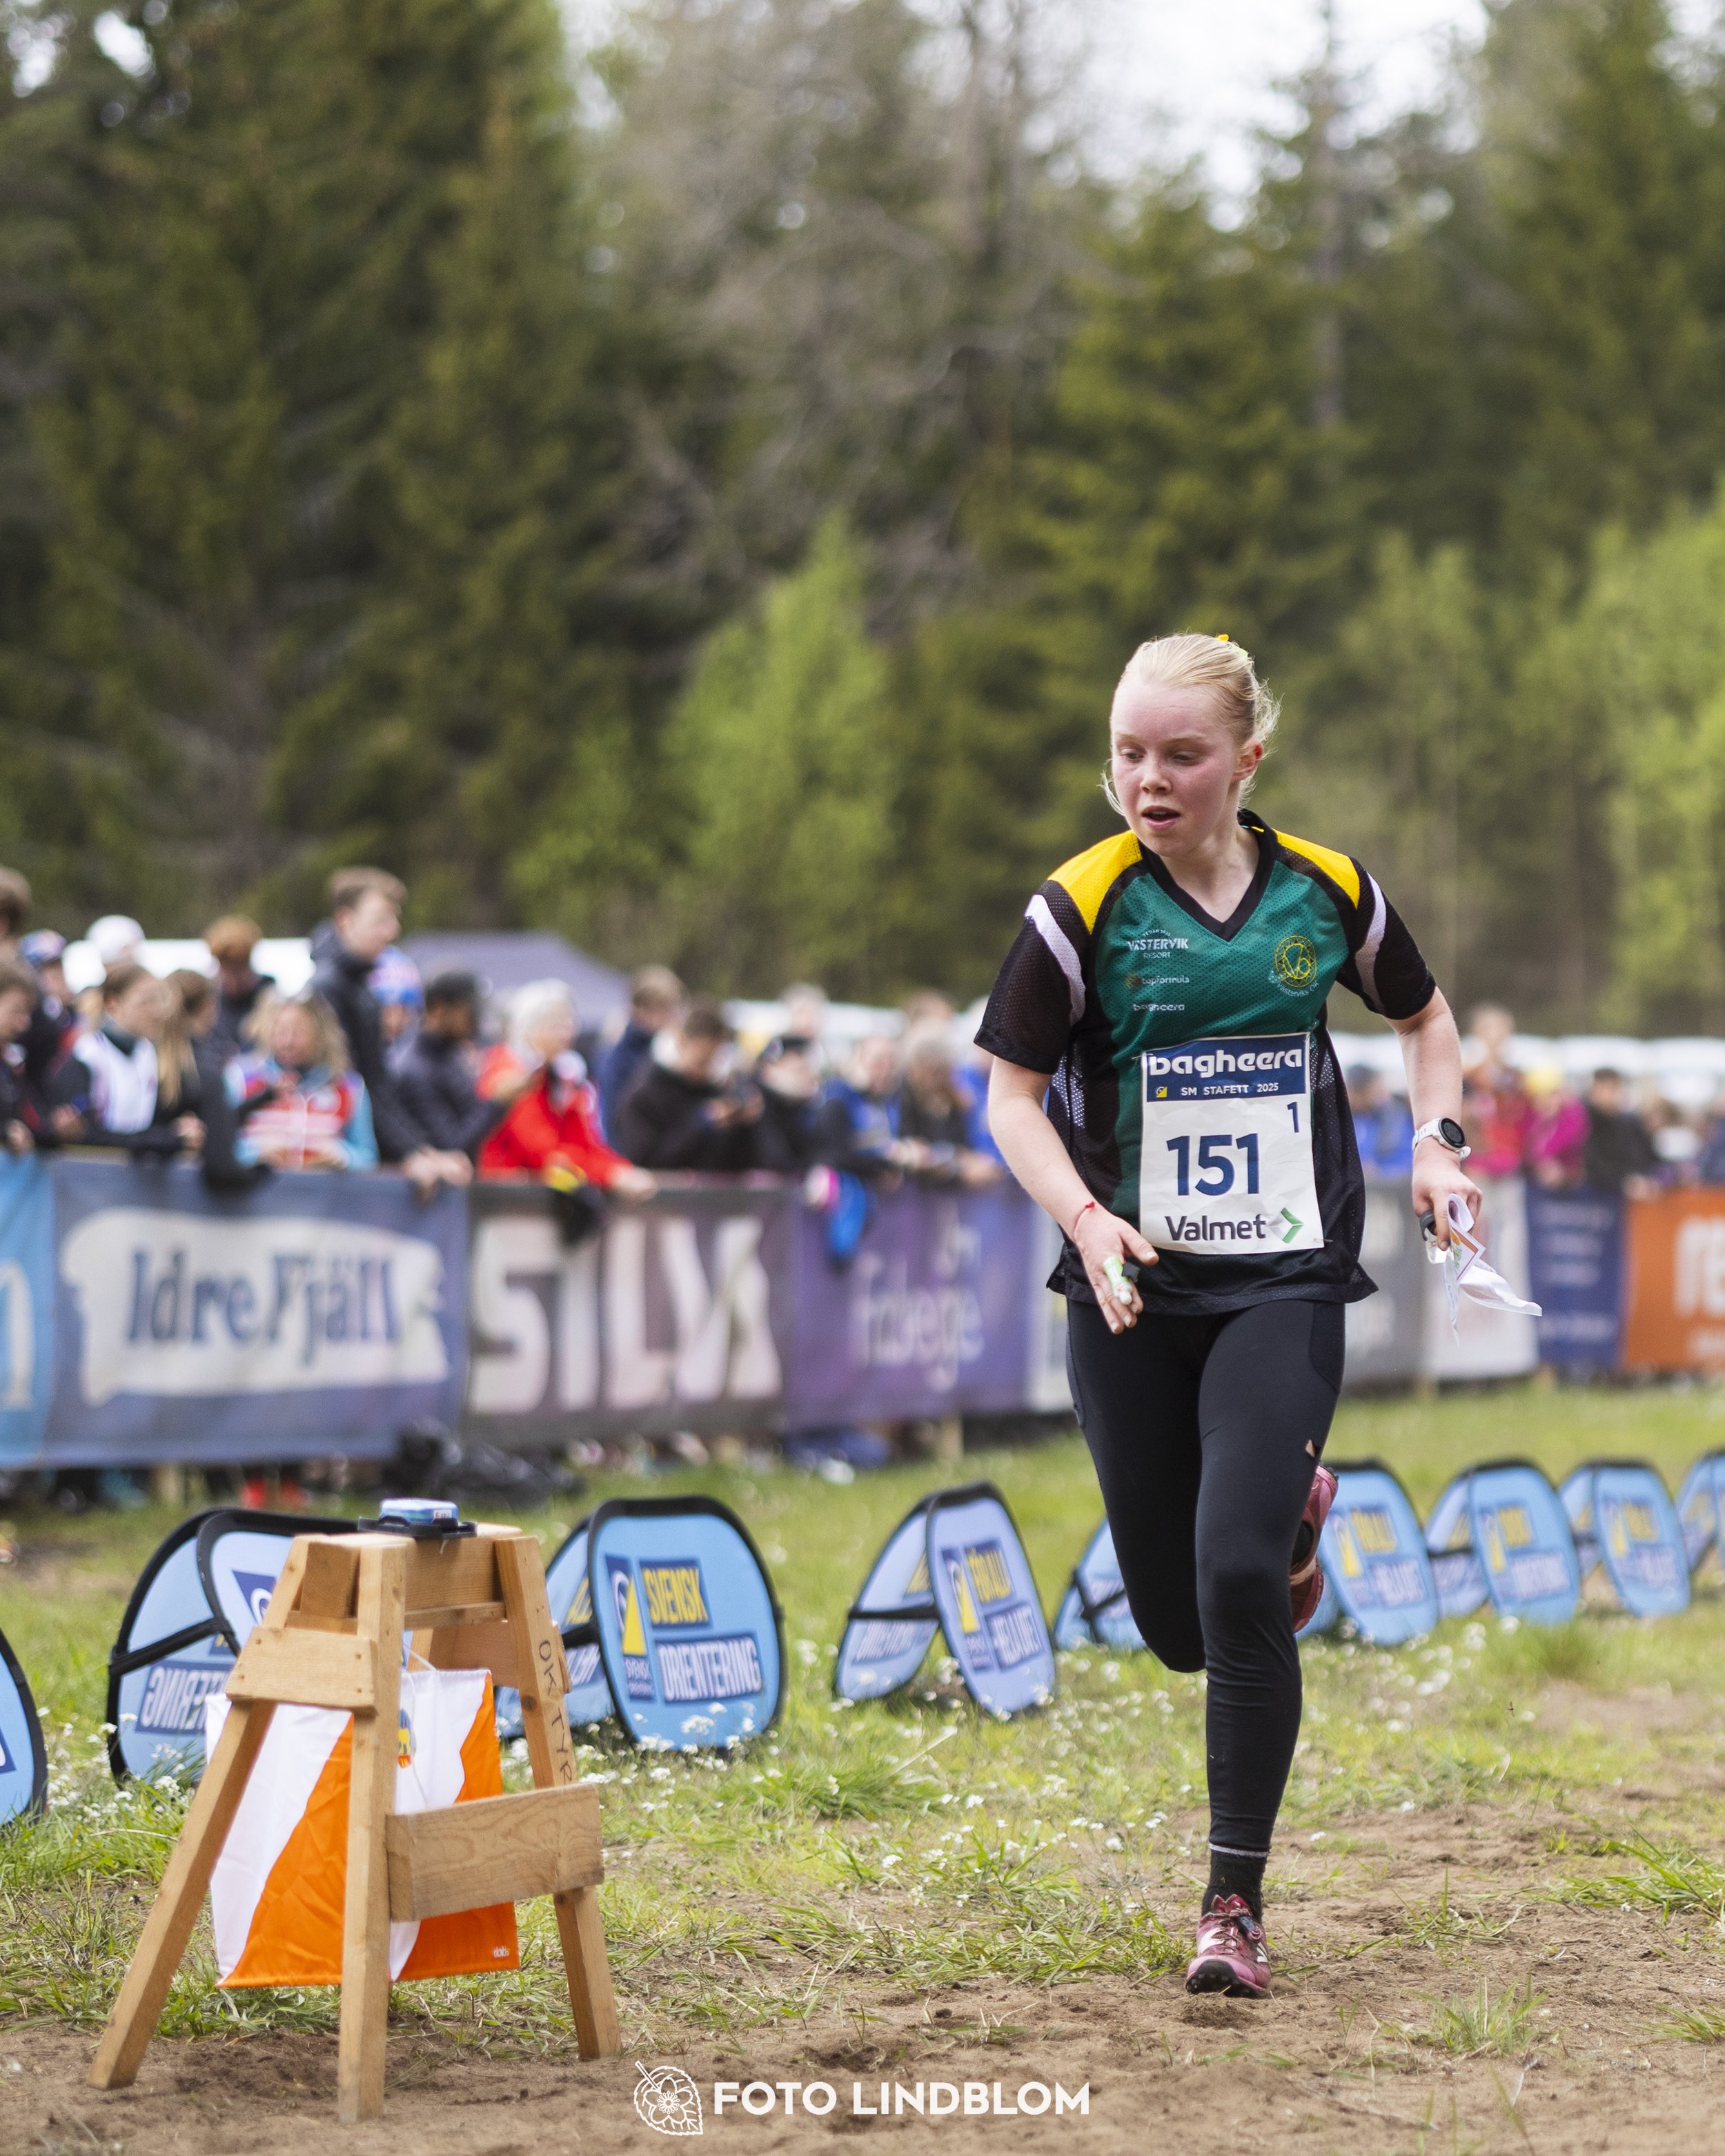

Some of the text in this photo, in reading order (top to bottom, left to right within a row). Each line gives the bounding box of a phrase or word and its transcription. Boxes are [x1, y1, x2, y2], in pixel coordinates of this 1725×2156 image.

[1127, 938, 1189, 951] VÄSTERVIK
[1150, 1049, 1303, 1078] bagheera
[1181, 1082, 1279, 1096] SM STAFETT 2025
[1287, 1101, 1300, 1133] 1
[1166, 1133, 1260, 1196] 151
[1164, 1213, 1267, 1241] Valmet
[642, 1566, 709, 1624] SVENSK
[538, 1639, 557, 1696] OK
[657, 1636, 762, 1701] ORIENTERING
